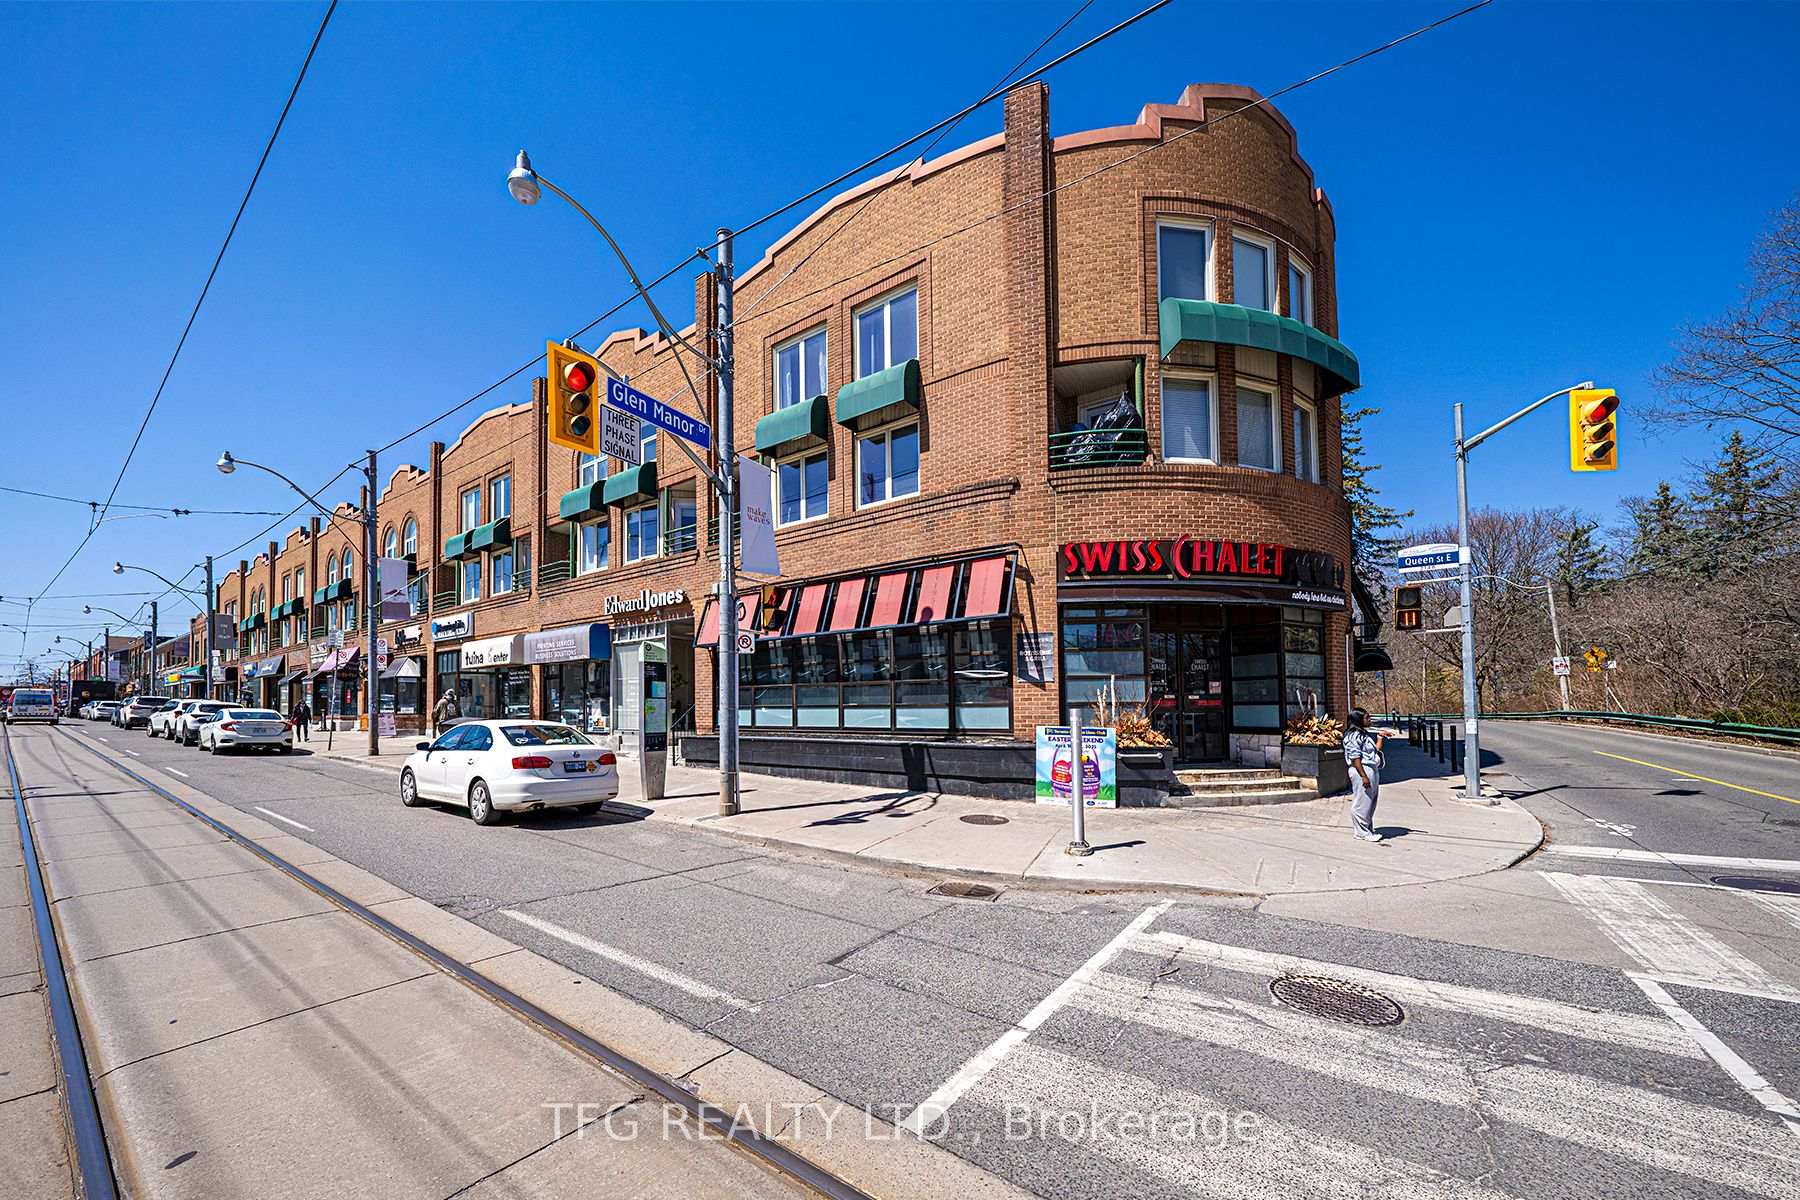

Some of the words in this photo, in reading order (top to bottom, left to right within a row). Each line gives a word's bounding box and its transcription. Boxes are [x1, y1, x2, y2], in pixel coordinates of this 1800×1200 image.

[612, 383, 647, 414] Glen
[653, 402, 695, 435] Manor
[698, 424, 706, 434] Dr
[607, 409, 635, 432] THREE
[605, 425, 636, 447] PHASE
[604, 440, 637, 462] SIGNAL
[1064, 540, 1163, 573] SWISS
[1172, 534, 1285, 578] CHALET
[1405, 556, 1434, 566] Queen
[1446, 553, 1452, 562] E
